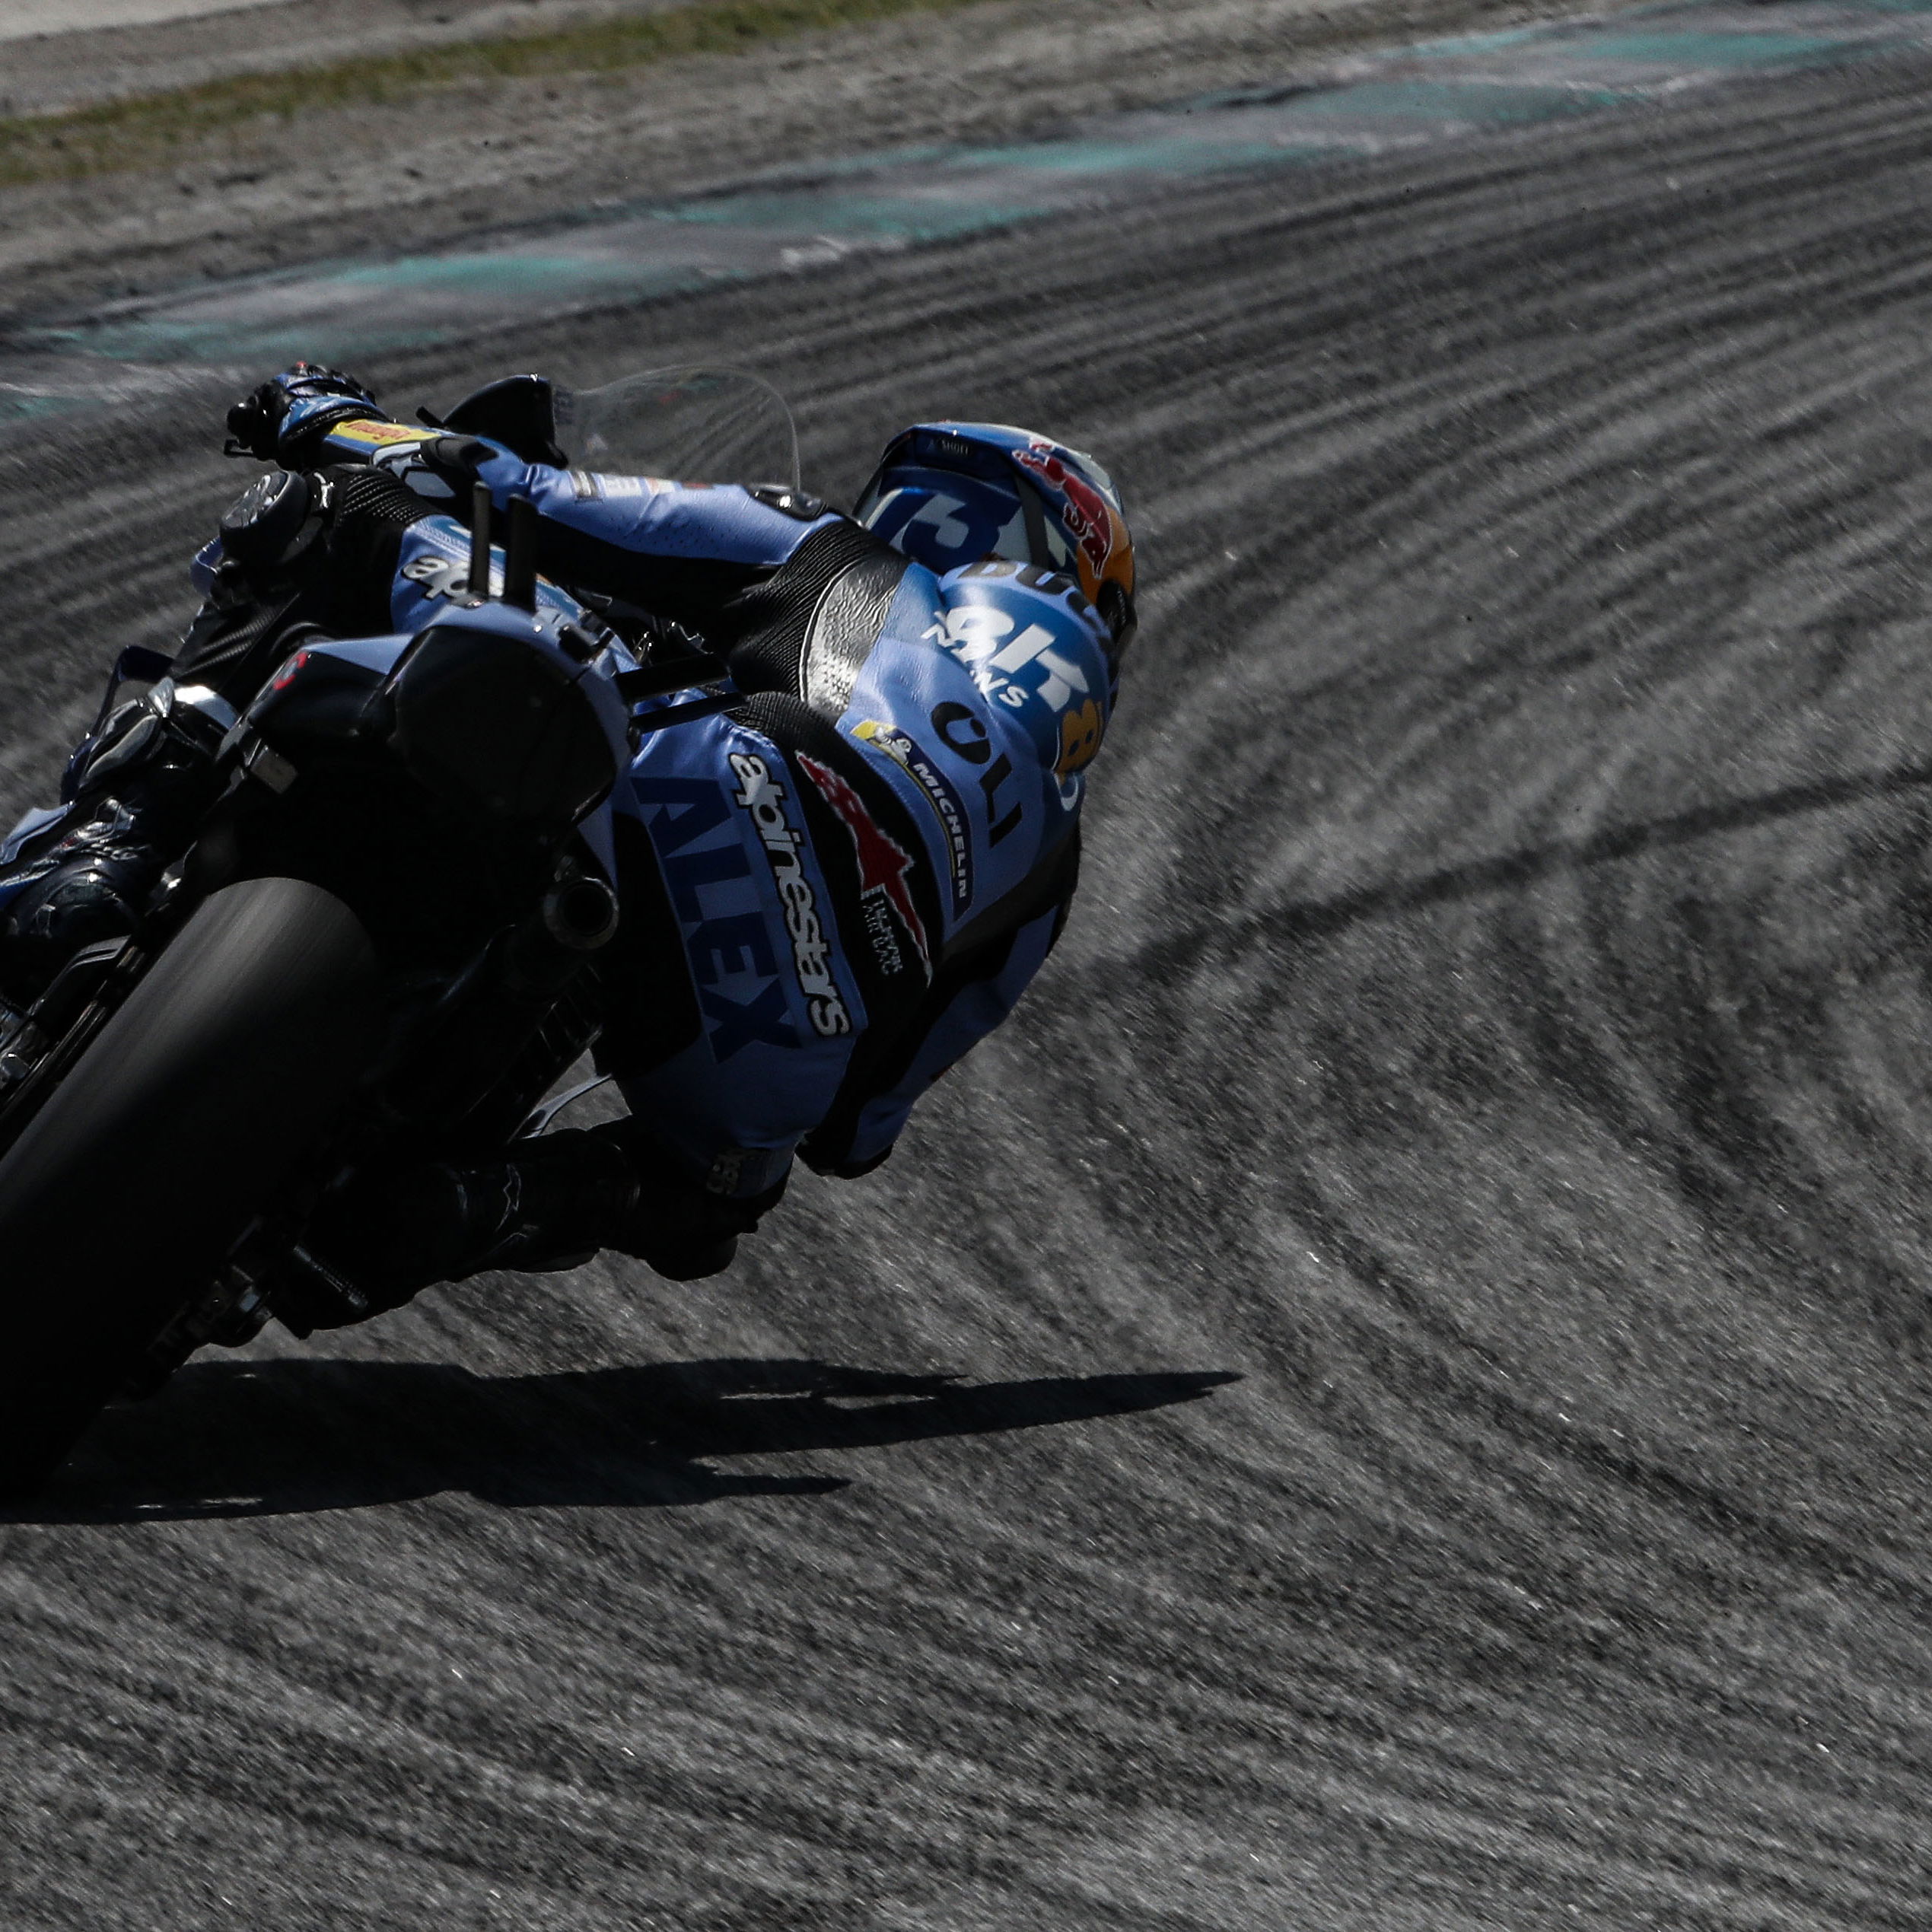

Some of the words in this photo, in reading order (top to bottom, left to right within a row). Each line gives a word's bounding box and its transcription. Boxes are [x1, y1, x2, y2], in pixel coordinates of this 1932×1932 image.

[629, 775, 804, 1065] ALEX
[728, 752, 853, 1037] alpinestars
[912, 761, 969, 899] MICHELIN
